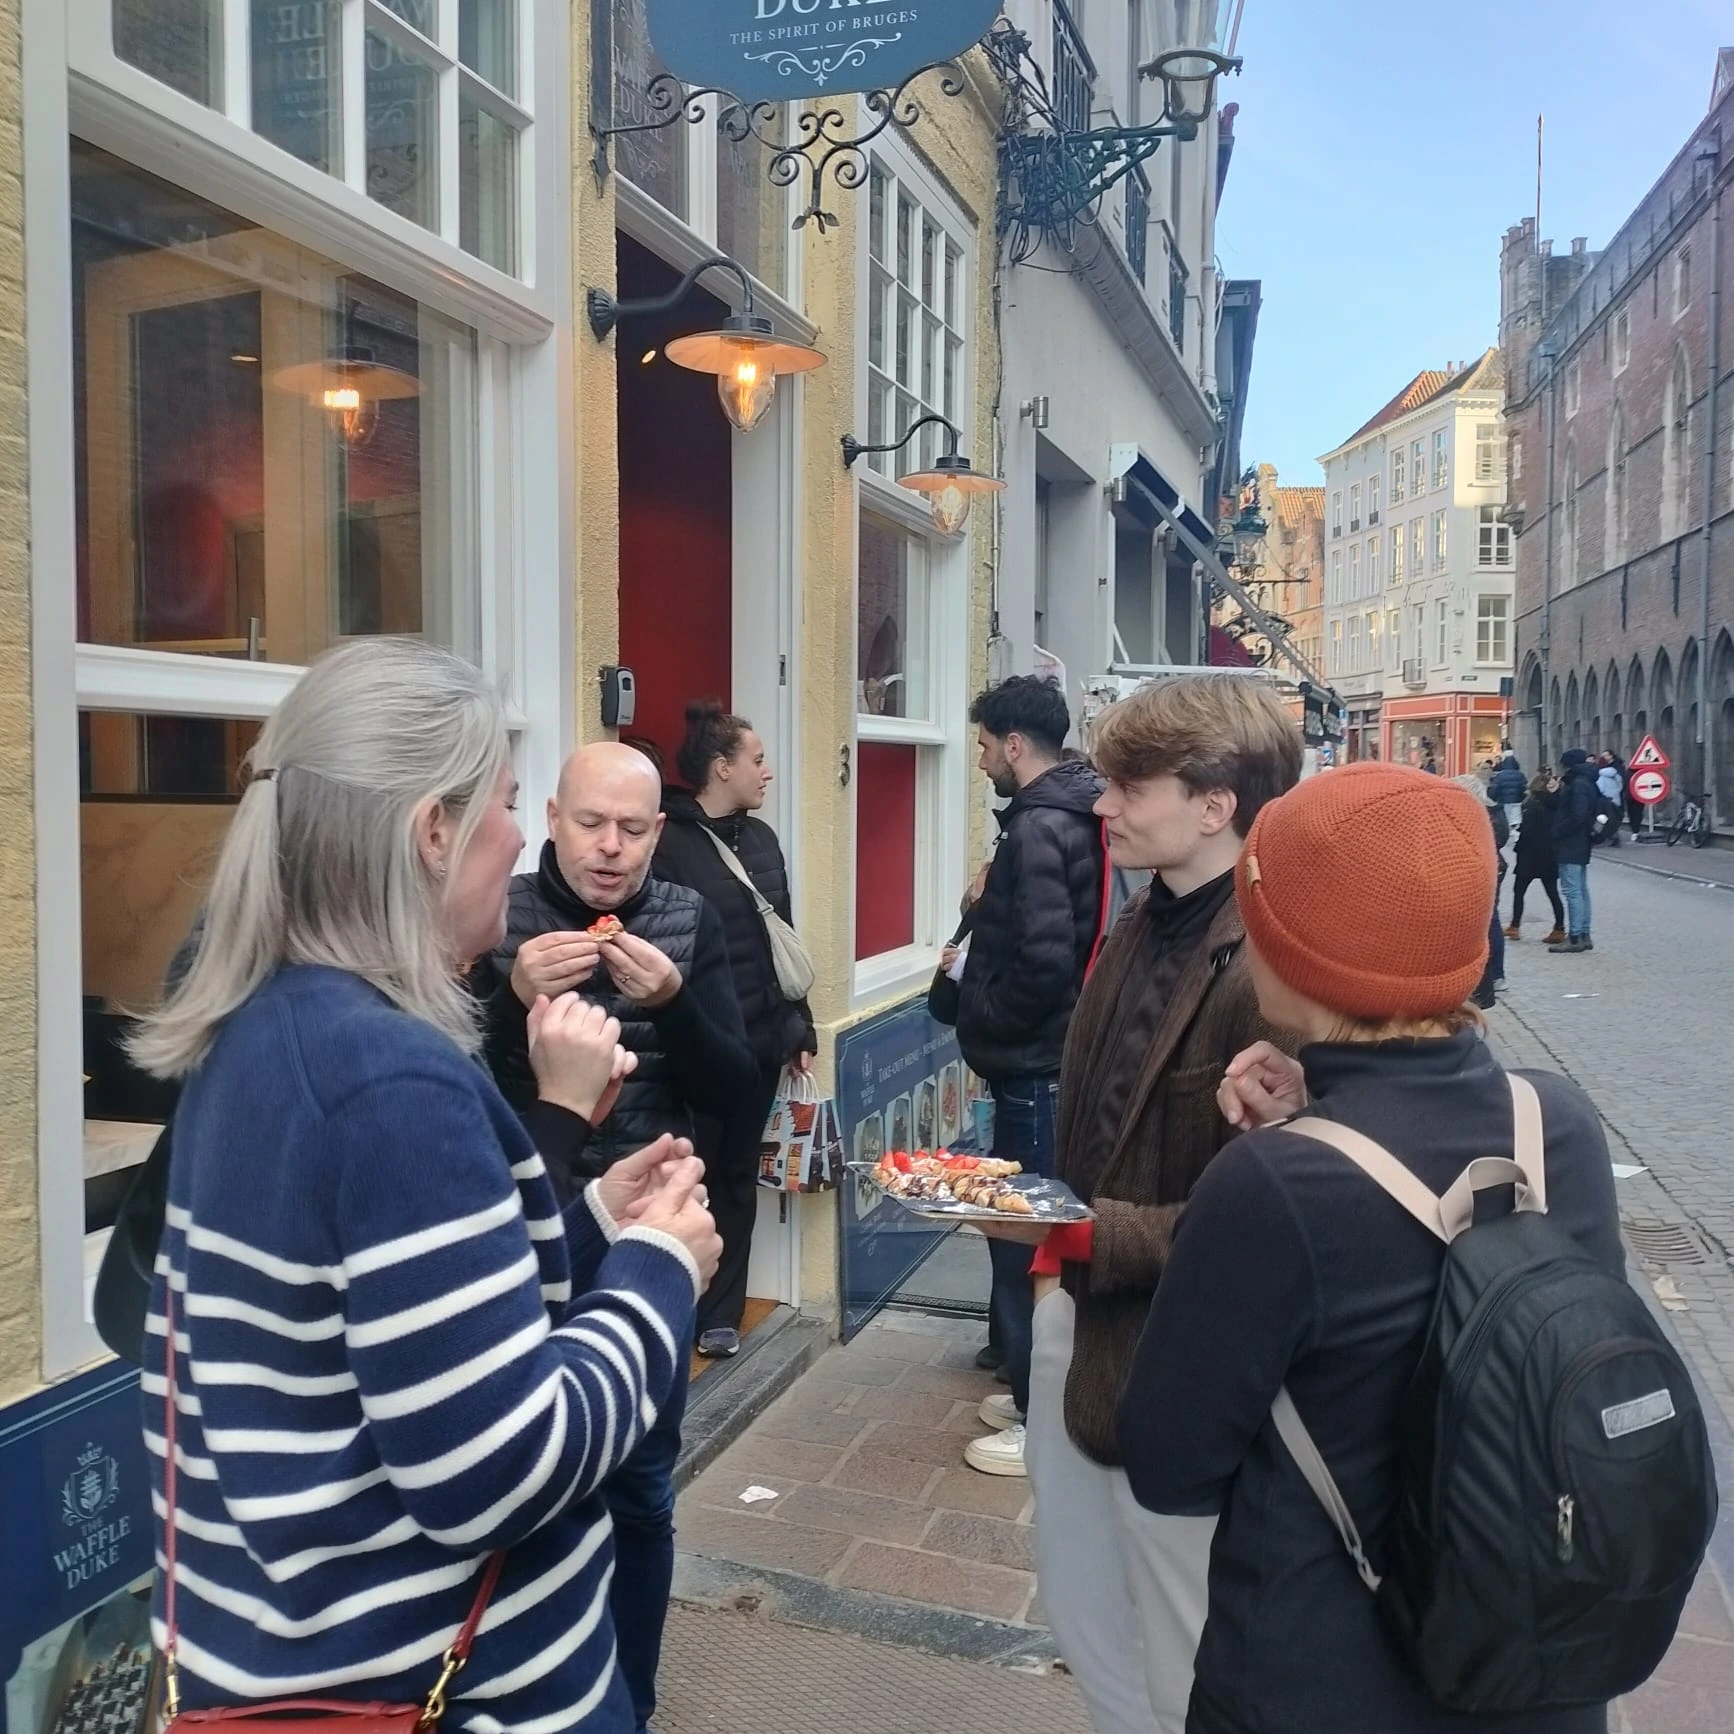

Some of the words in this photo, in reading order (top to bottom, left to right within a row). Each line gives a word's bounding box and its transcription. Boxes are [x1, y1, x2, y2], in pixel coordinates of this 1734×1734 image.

[730, 31, 762, 44] THE
[768, 23, 820, 40] SPIRIT
[825, 19, 847, 33] OF
[852, 9, 918, 29] BRUGES
[53, 1515, 131, 1572] WAFFLE
[67, 1544, 120, 1590] DUKE
